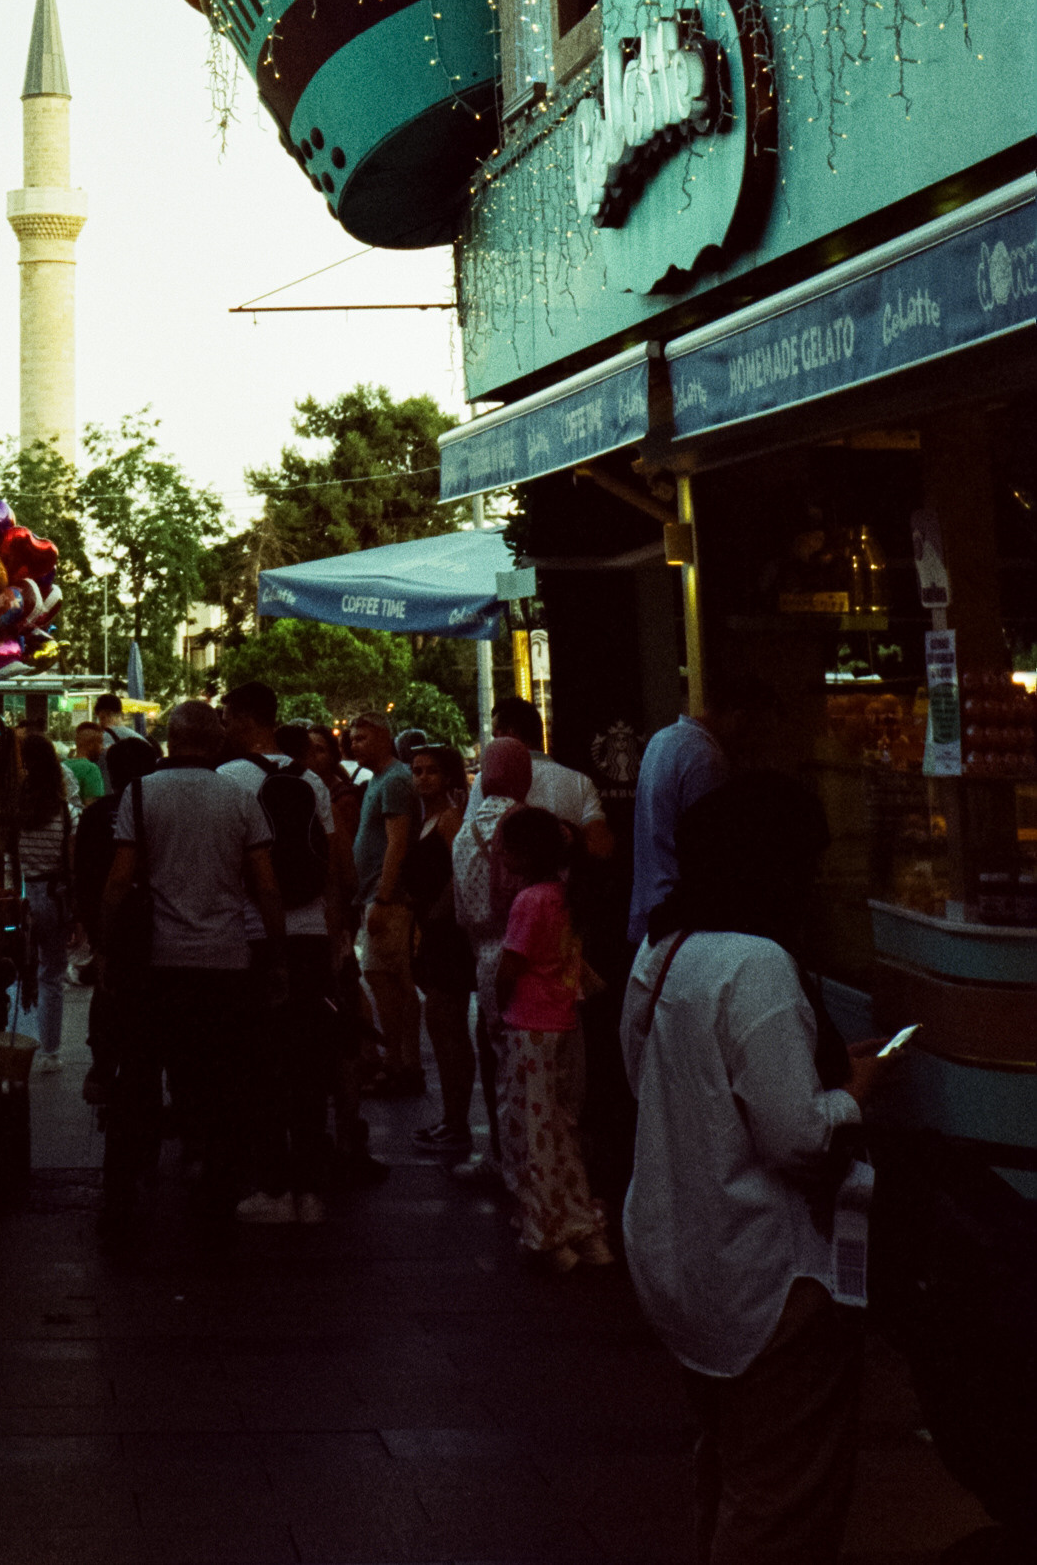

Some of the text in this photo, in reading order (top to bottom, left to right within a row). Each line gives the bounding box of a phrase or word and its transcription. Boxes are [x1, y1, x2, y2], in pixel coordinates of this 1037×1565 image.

[729, 315, 855, 398] HOMEMADE GELATO
[341, 593, 407, 620] COFFEE TIME
